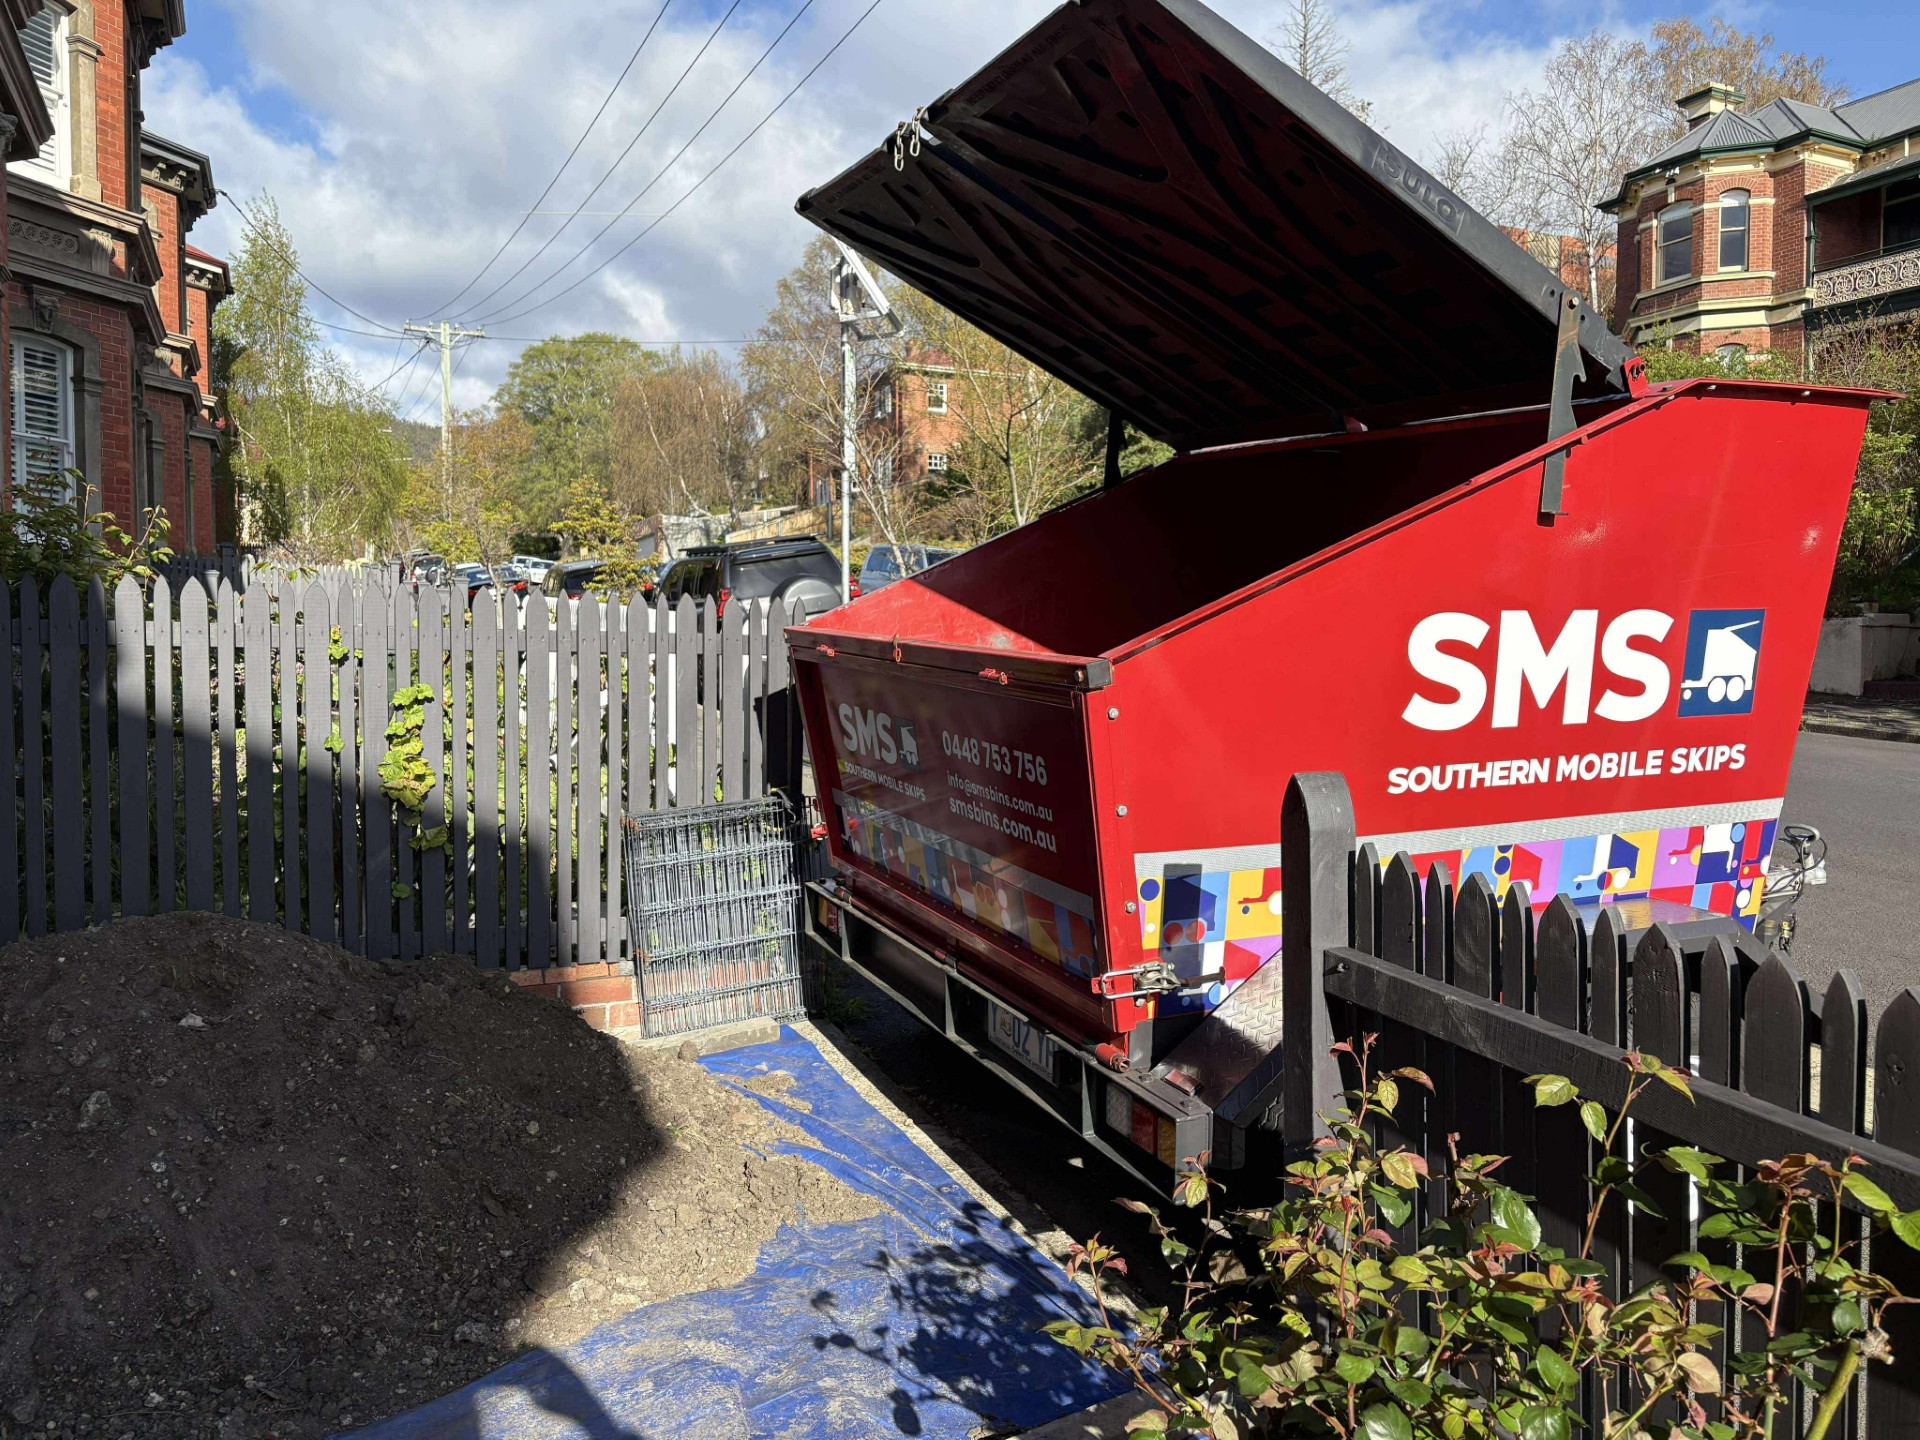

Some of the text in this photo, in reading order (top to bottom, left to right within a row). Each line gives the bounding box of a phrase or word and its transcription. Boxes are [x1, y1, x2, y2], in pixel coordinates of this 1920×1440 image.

[1381, 153, 1458, 223] SULO
[1401, 608, 1675, 731] SMS
[838, 702, 897, 765] SMS
[942, 730, 1048, 786] 0448 753 756
[844, 761, 926, 802] SOUTHERN MOBILE SKIPS
[947, 770, 1053, 822] info@smsbins.com.au
[1387, 743, 1747, 795] SOUTHERN MOBILE SKIPS
[949, 796, 1057, 853] smsbins.com.au
